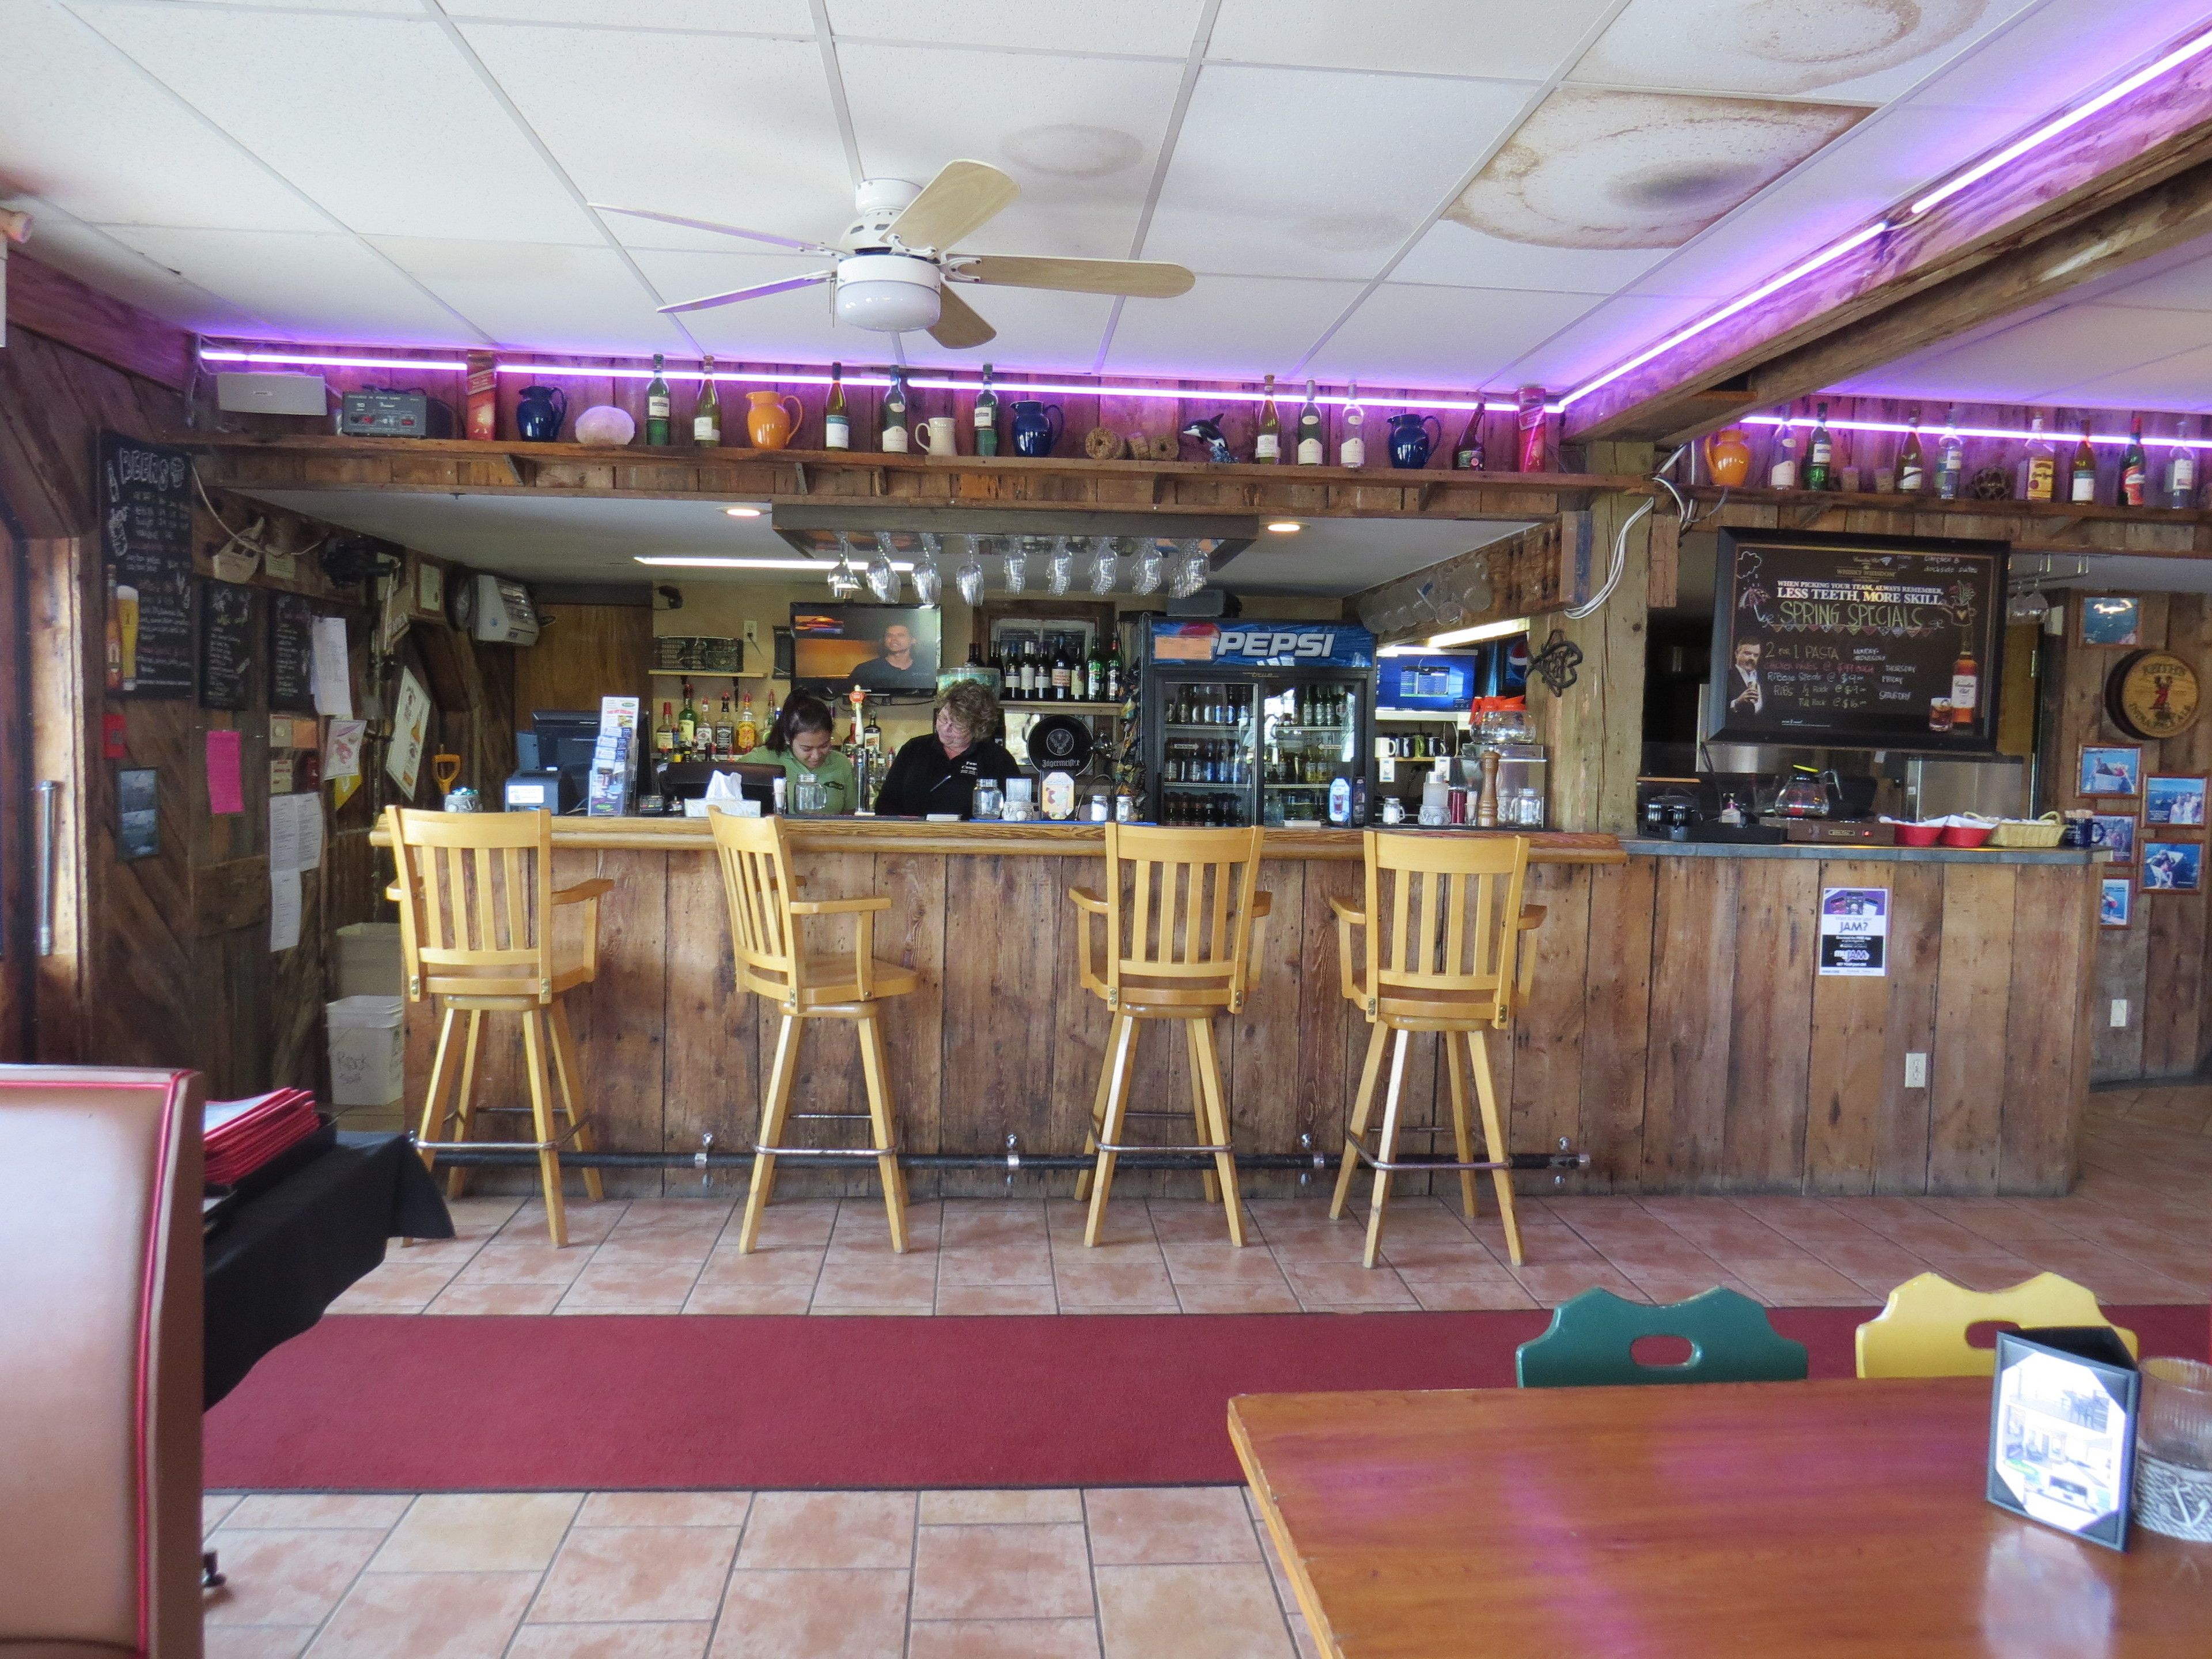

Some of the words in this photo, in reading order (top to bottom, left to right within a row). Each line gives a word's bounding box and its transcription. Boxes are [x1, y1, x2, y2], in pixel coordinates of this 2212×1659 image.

[1801, 581, 1831, 589] PICKING
[1777, 587, 1809, 599] LESS
[1811, 588, 1860, 603] TEETH,
[1863, 591, 1901, 603] MORE
[1780, 601, 1840, 626] SPRING
[1846, 603, 1924, 629] SPECIALS
[1216, 631, 1335, 657] PEPSI
[1765, 641, 1774, 658] 2
[1805, 645, 1839, 660] PASTA
[1839, 922, 1868, 933] JAM?
